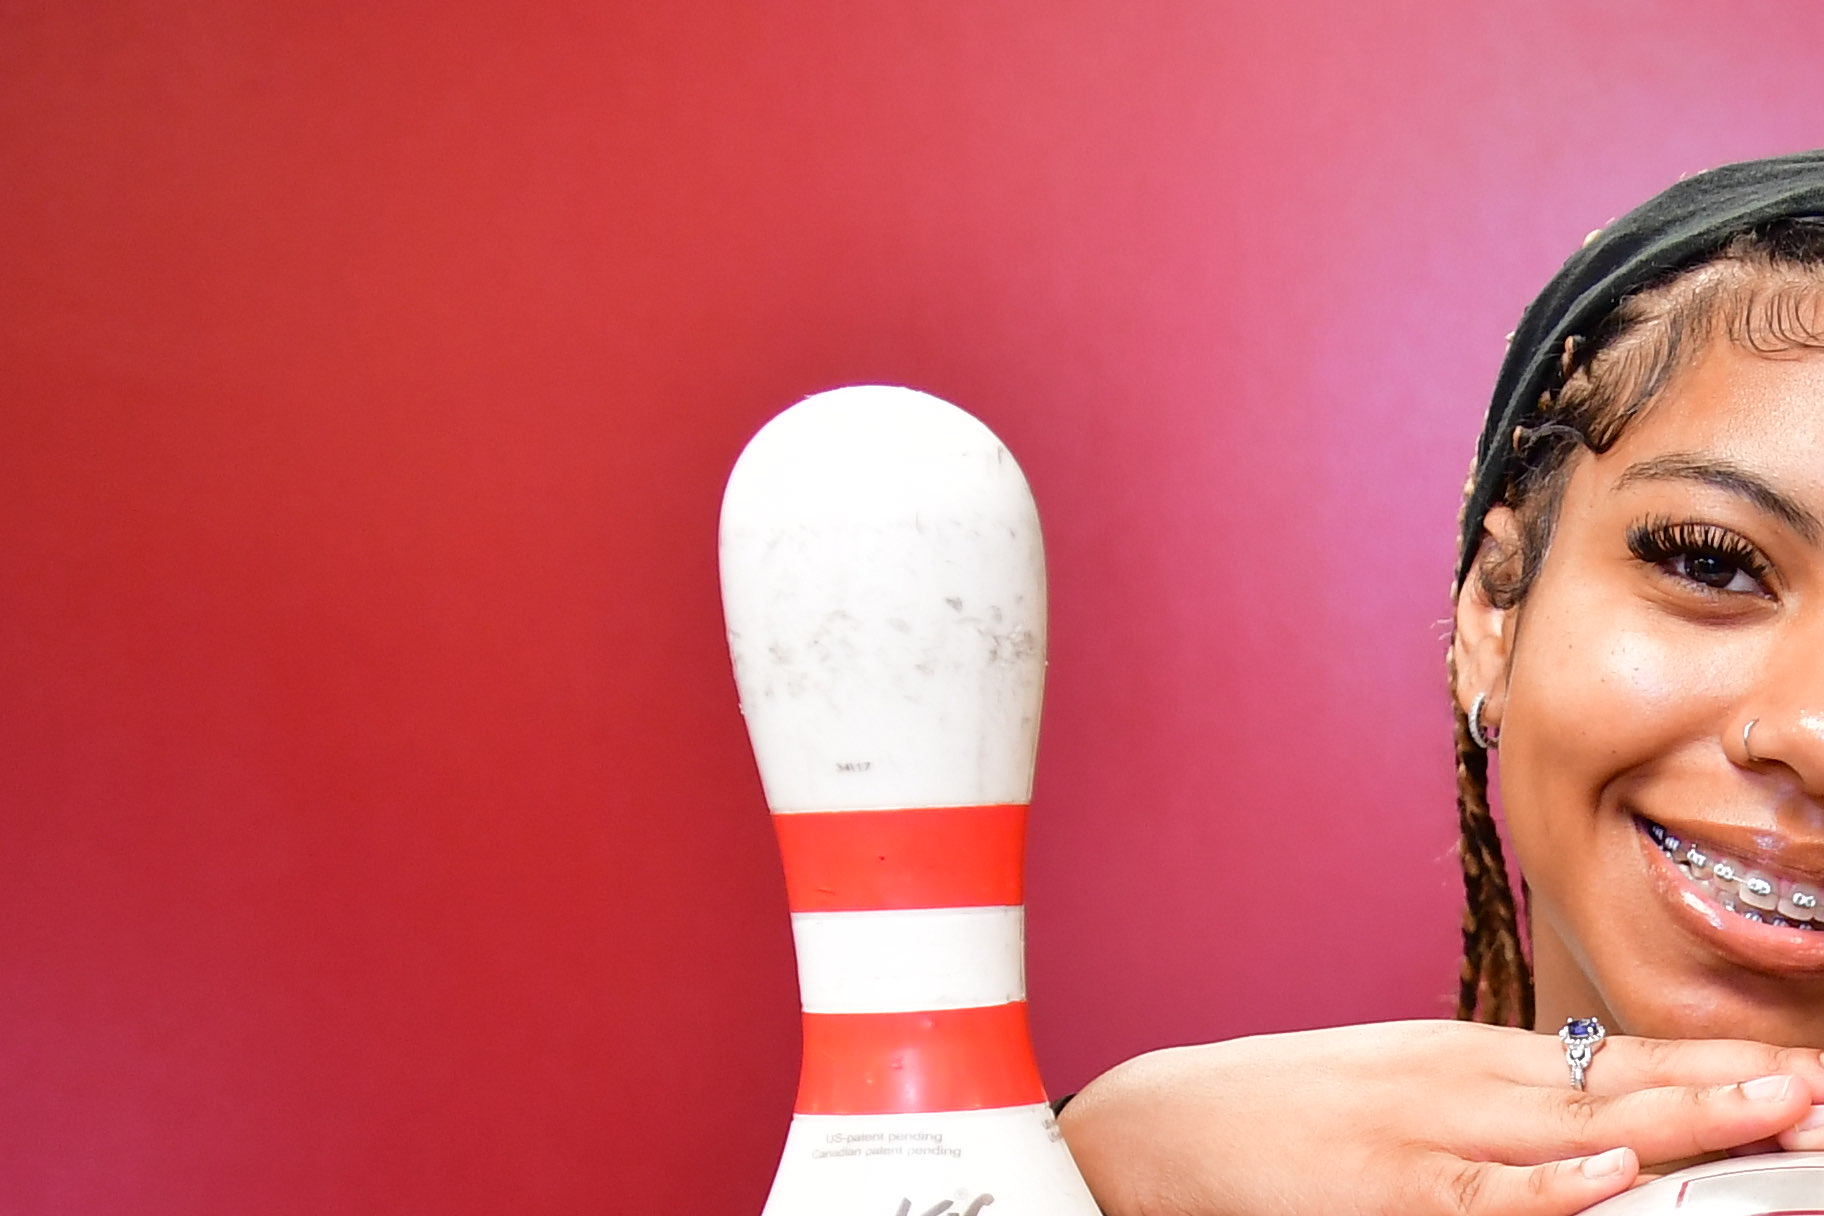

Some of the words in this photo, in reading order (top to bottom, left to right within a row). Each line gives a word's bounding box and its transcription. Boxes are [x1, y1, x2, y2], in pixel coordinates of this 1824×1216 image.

[888, 1131, 943, 1144] pending
[811, 1147, 862, 1159] Canadian
[865, 1146, 903, 1158] patent
[907, 1145, 962, 1158] pending
